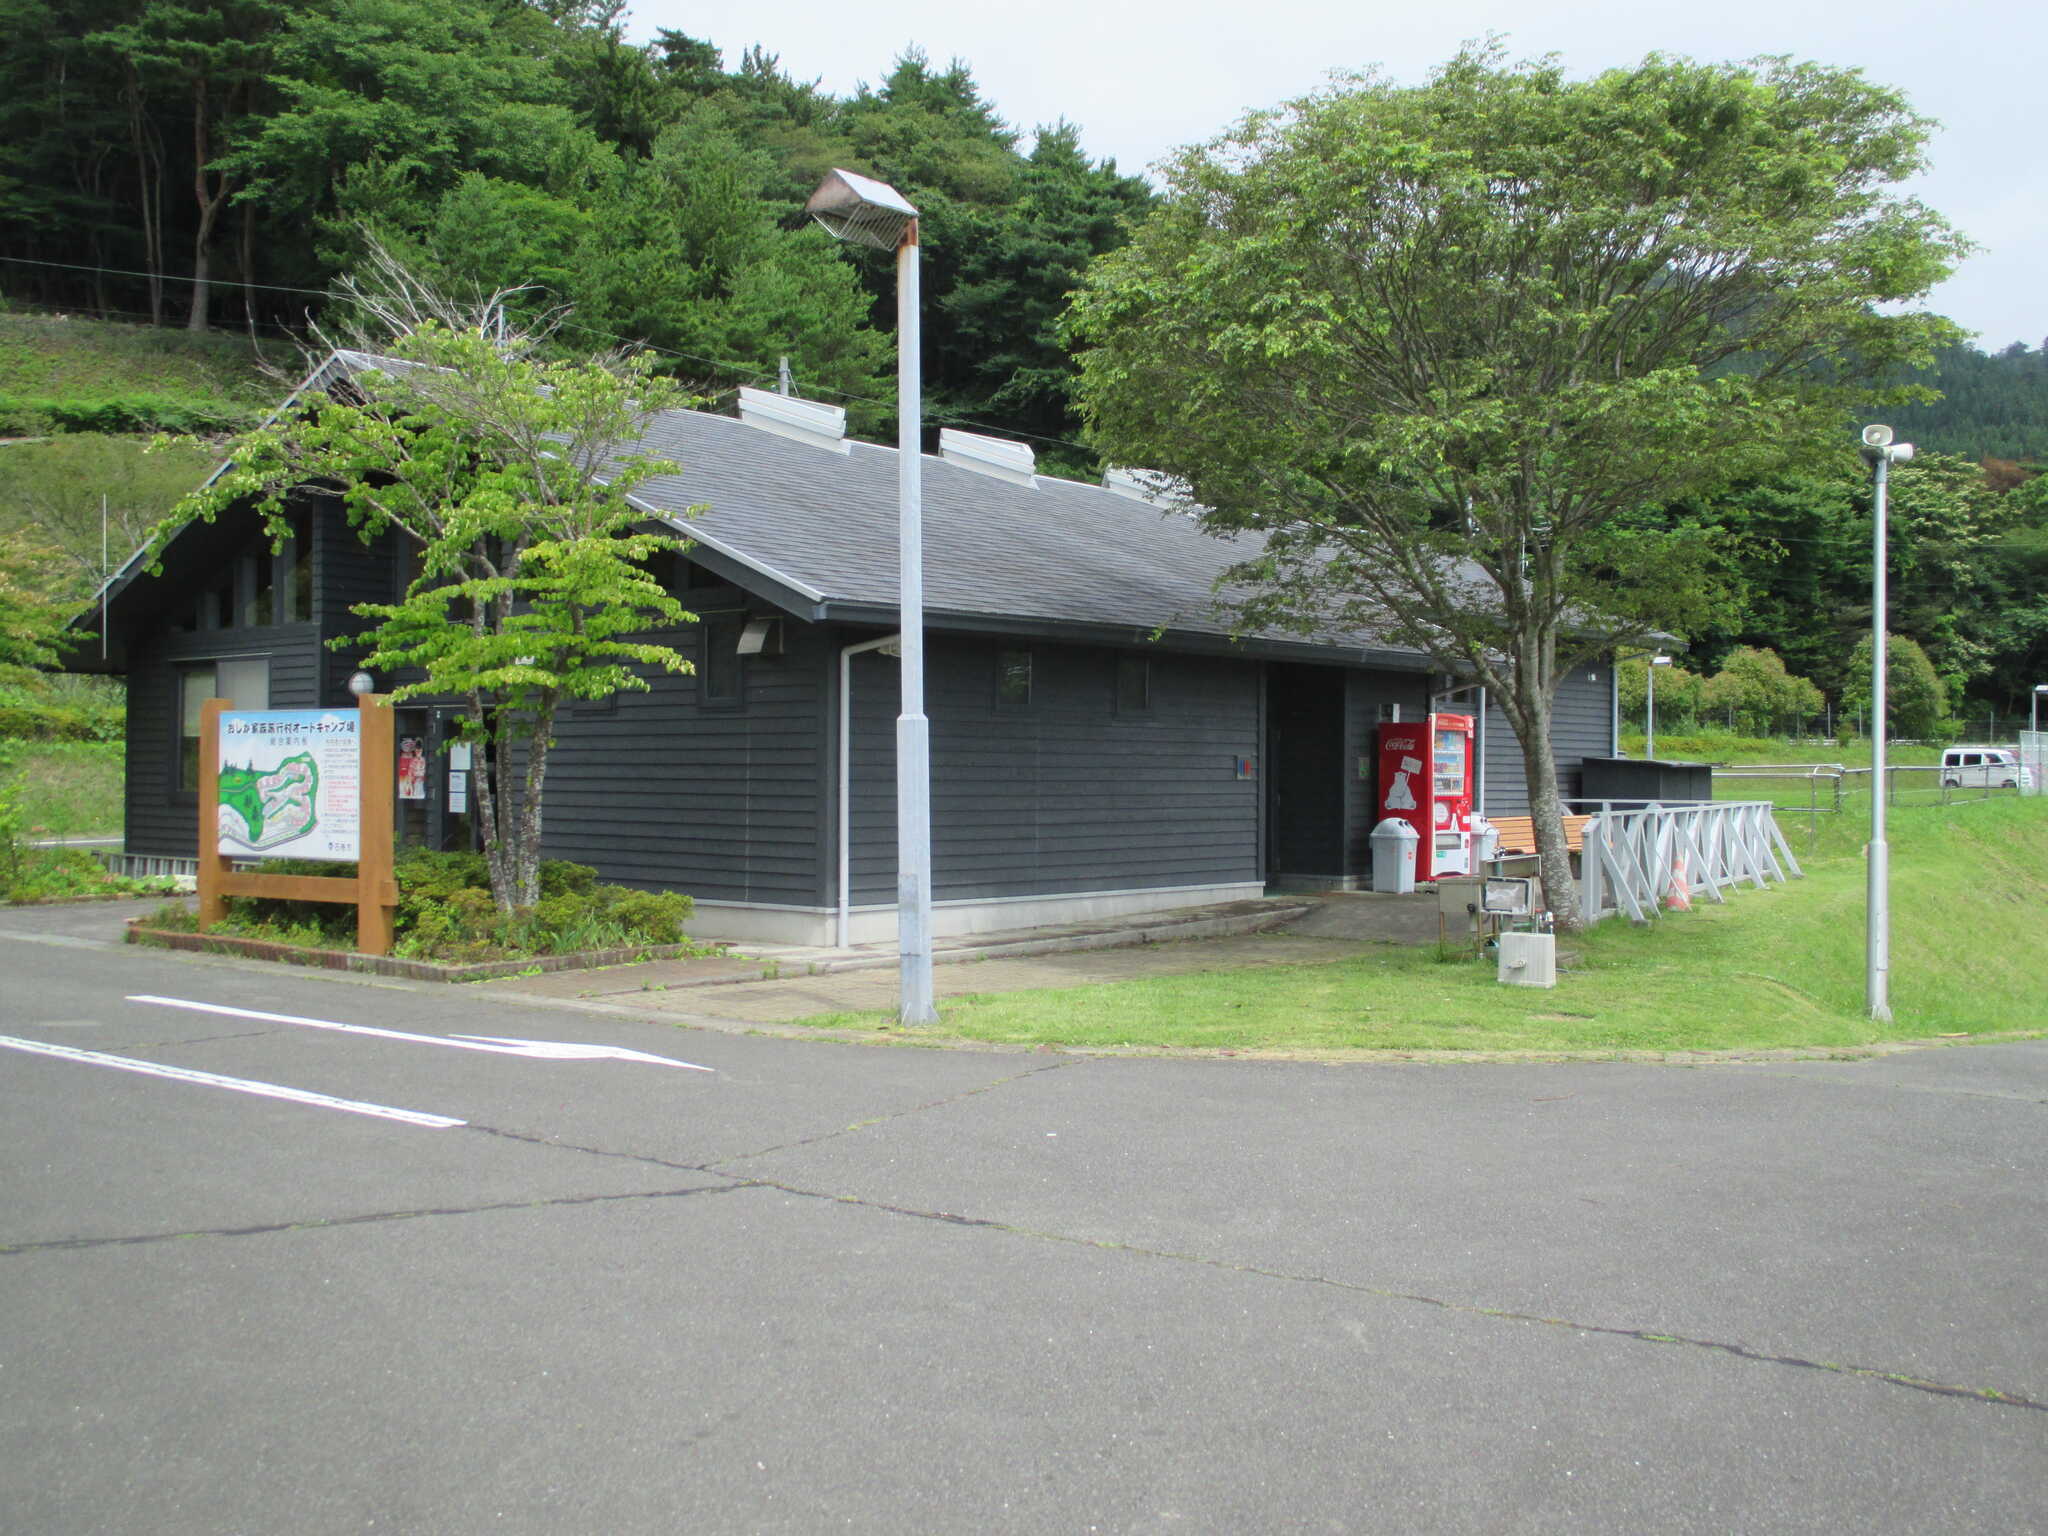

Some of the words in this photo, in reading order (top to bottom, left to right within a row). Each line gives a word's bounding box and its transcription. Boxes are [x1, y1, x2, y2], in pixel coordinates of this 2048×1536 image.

[227, 720, 355, 734] おしか家族旅行村オートキャンプ場
